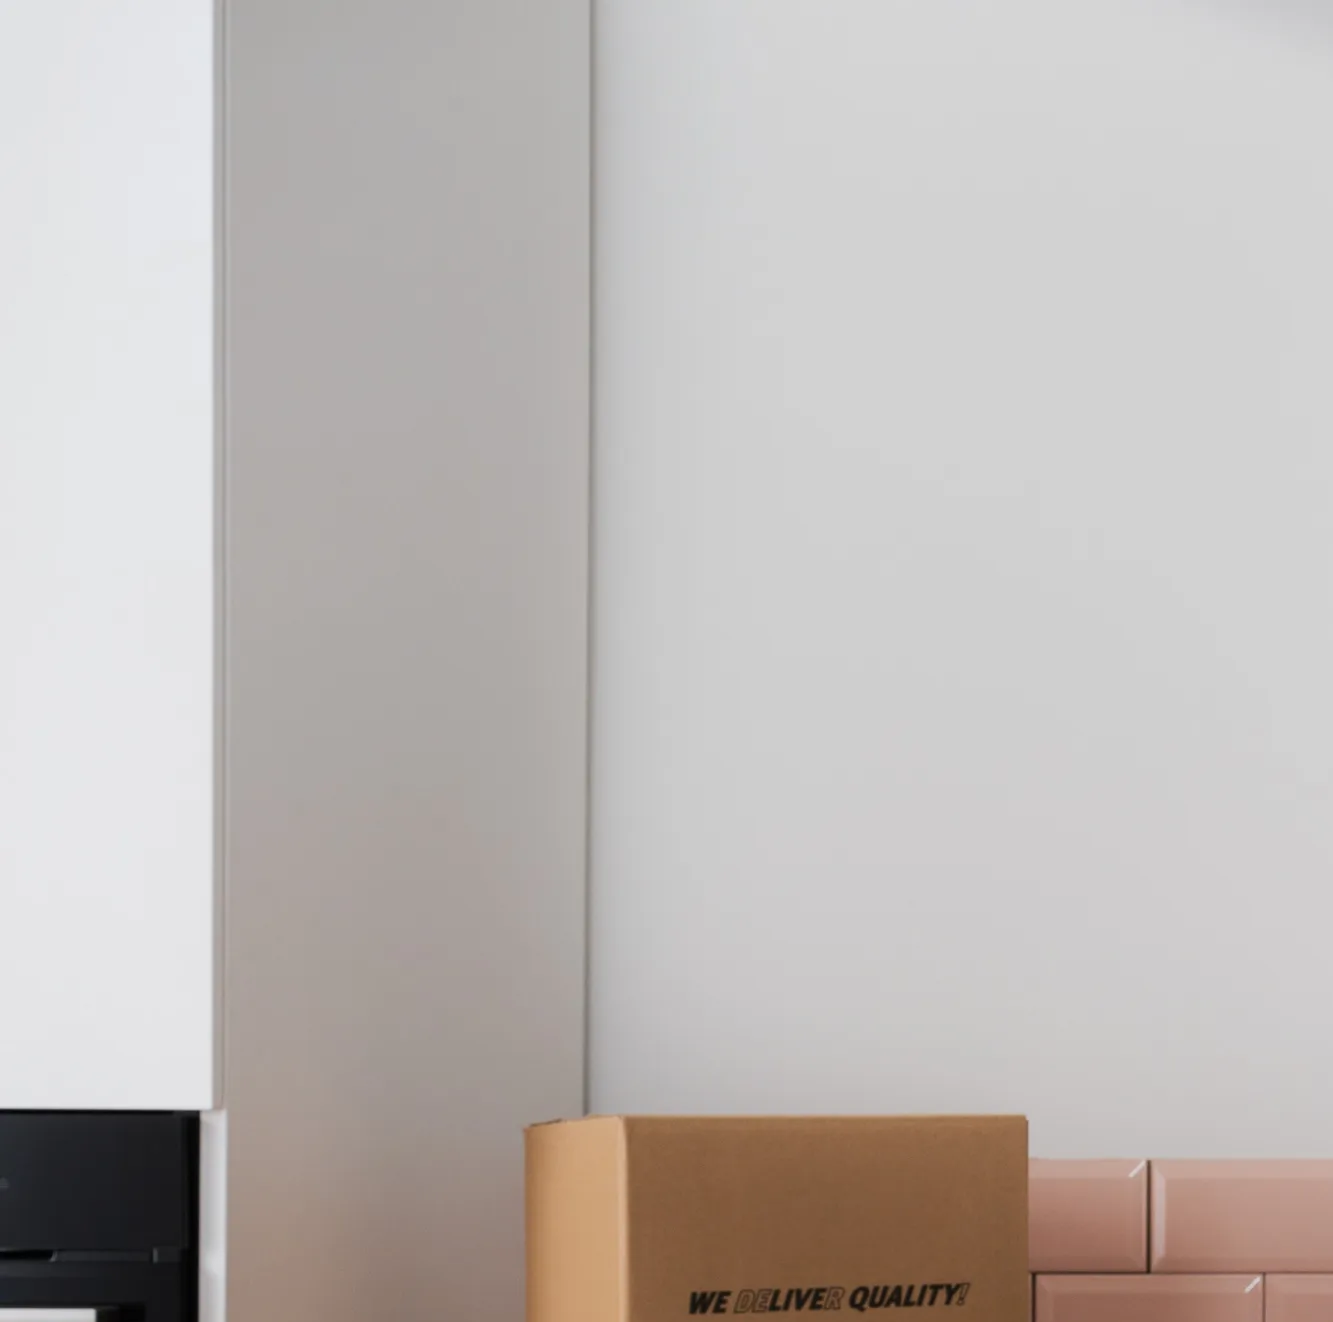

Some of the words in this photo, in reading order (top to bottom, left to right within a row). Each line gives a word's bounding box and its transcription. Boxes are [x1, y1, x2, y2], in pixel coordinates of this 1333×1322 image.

[688, 1290, 732, 1315] WE
[733, 1286, 845, 1315] DELIVER
[848, 1282, 971, 1312] QUALITY!
